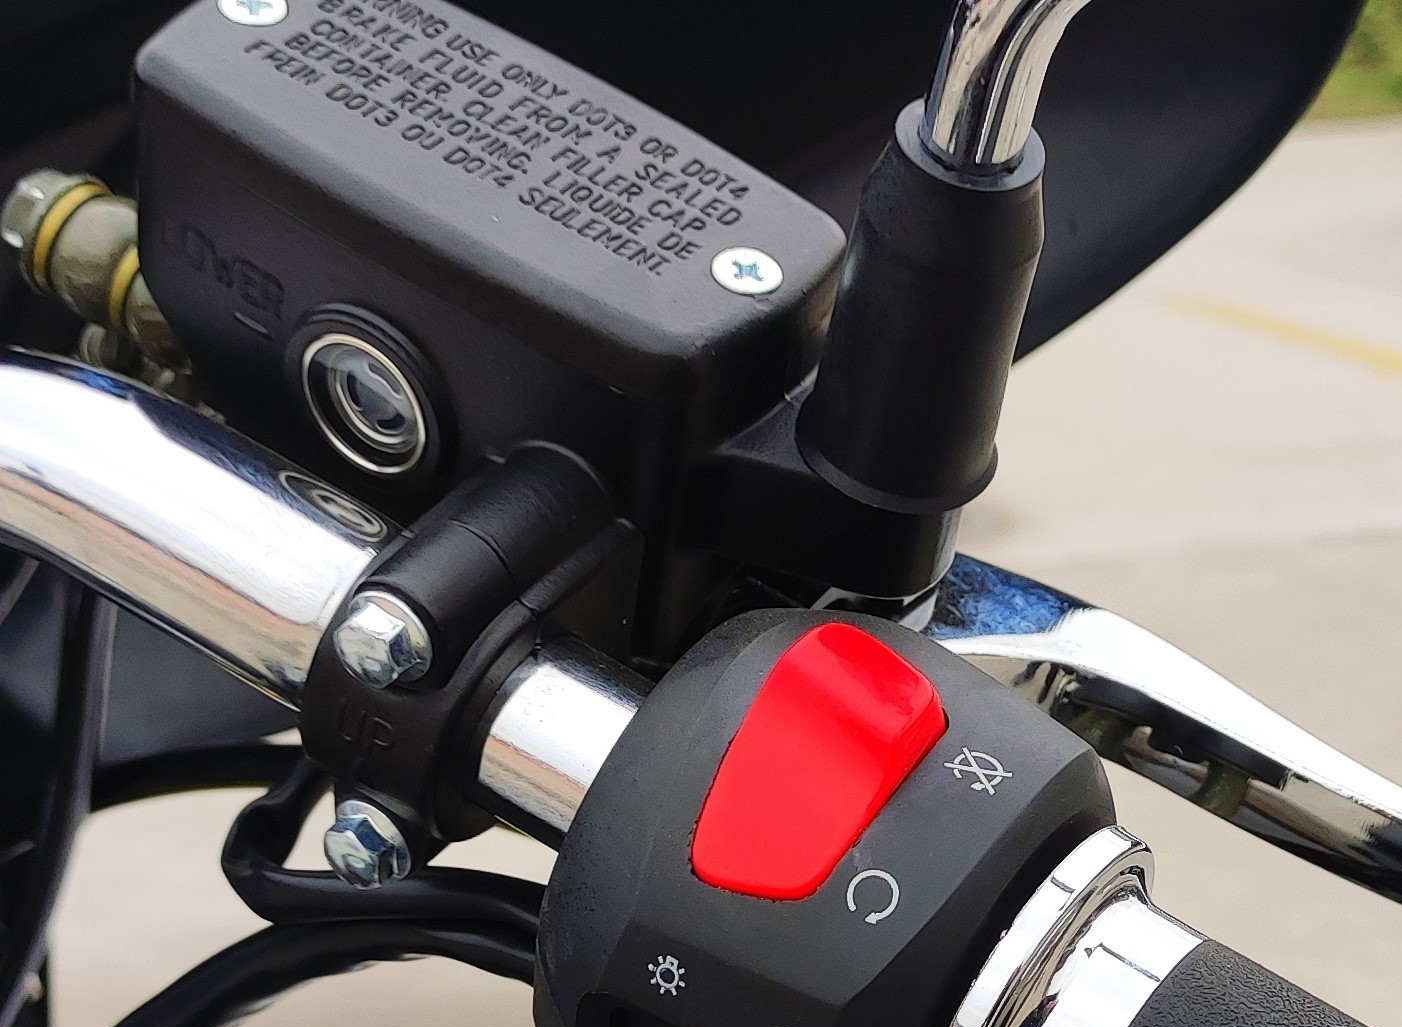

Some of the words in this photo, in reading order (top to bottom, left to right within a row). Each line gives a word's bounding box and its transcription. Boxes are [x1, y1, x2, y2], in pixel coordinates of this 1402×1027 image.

[243, 39, 326, 86] FREIN
[325, 83, 400, 127] DOT3
[401, 123, 446, 150] OU
[442, 147, 516, 188] DOT4
[284, 32, 391, 92] BEFORE
[542, 170, 651, 236] LIQUIDE
[656, 231, 703, 260] DE
[316, 0, 418, 52] BRAKE
[417, 48, 504, 98] FLUID
[508, 95, 594, 146] FROM
[595, 145, 622, 165] A
[634, 162, 743, 227] SEALED
[446, 33, 501, 67] USE
[501, 63, 569, 100] ONLY
[567, 97, 638, 141] DOT3
[640, 137, 678, 164] OR
[680, 157, 750, 200] DOT4
[462, 100, 551, 150] CLEAN
[550, 147, 644, 203] FILLER
[648, 199, 707, 232] CAP
